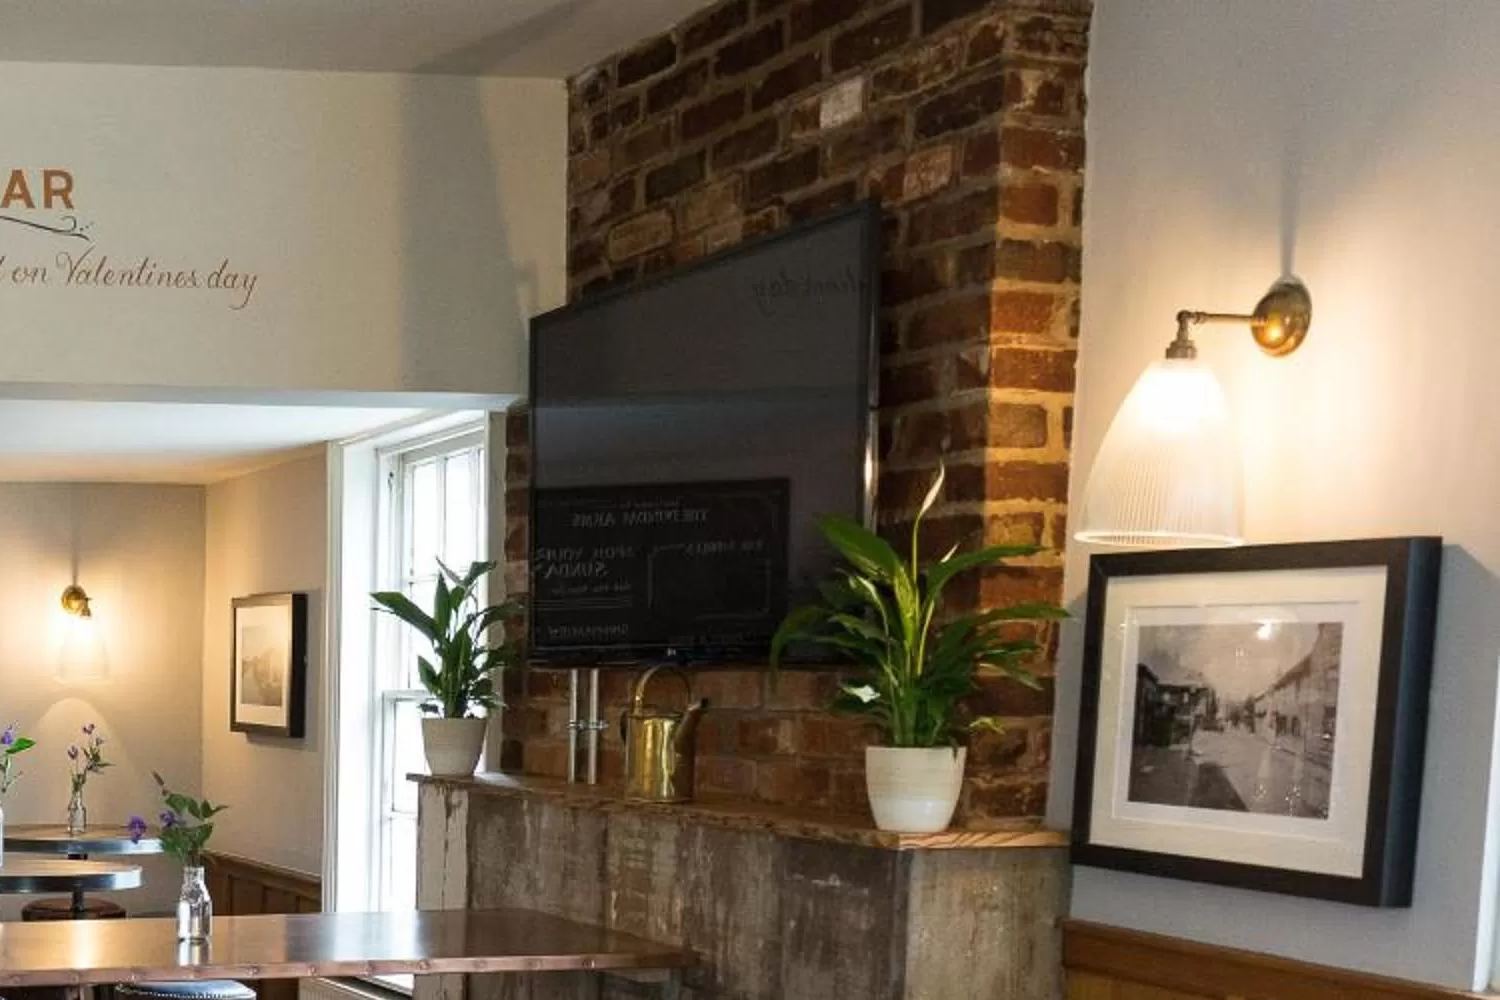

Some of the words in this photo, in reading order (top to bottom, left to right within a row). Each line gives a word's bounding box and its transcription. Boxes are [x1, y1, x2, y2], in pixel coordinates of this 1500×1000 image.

[11, 264, 48, 284] on
[55, 243, 200, 289] Valentines
[207, 256, 257, 310] day
